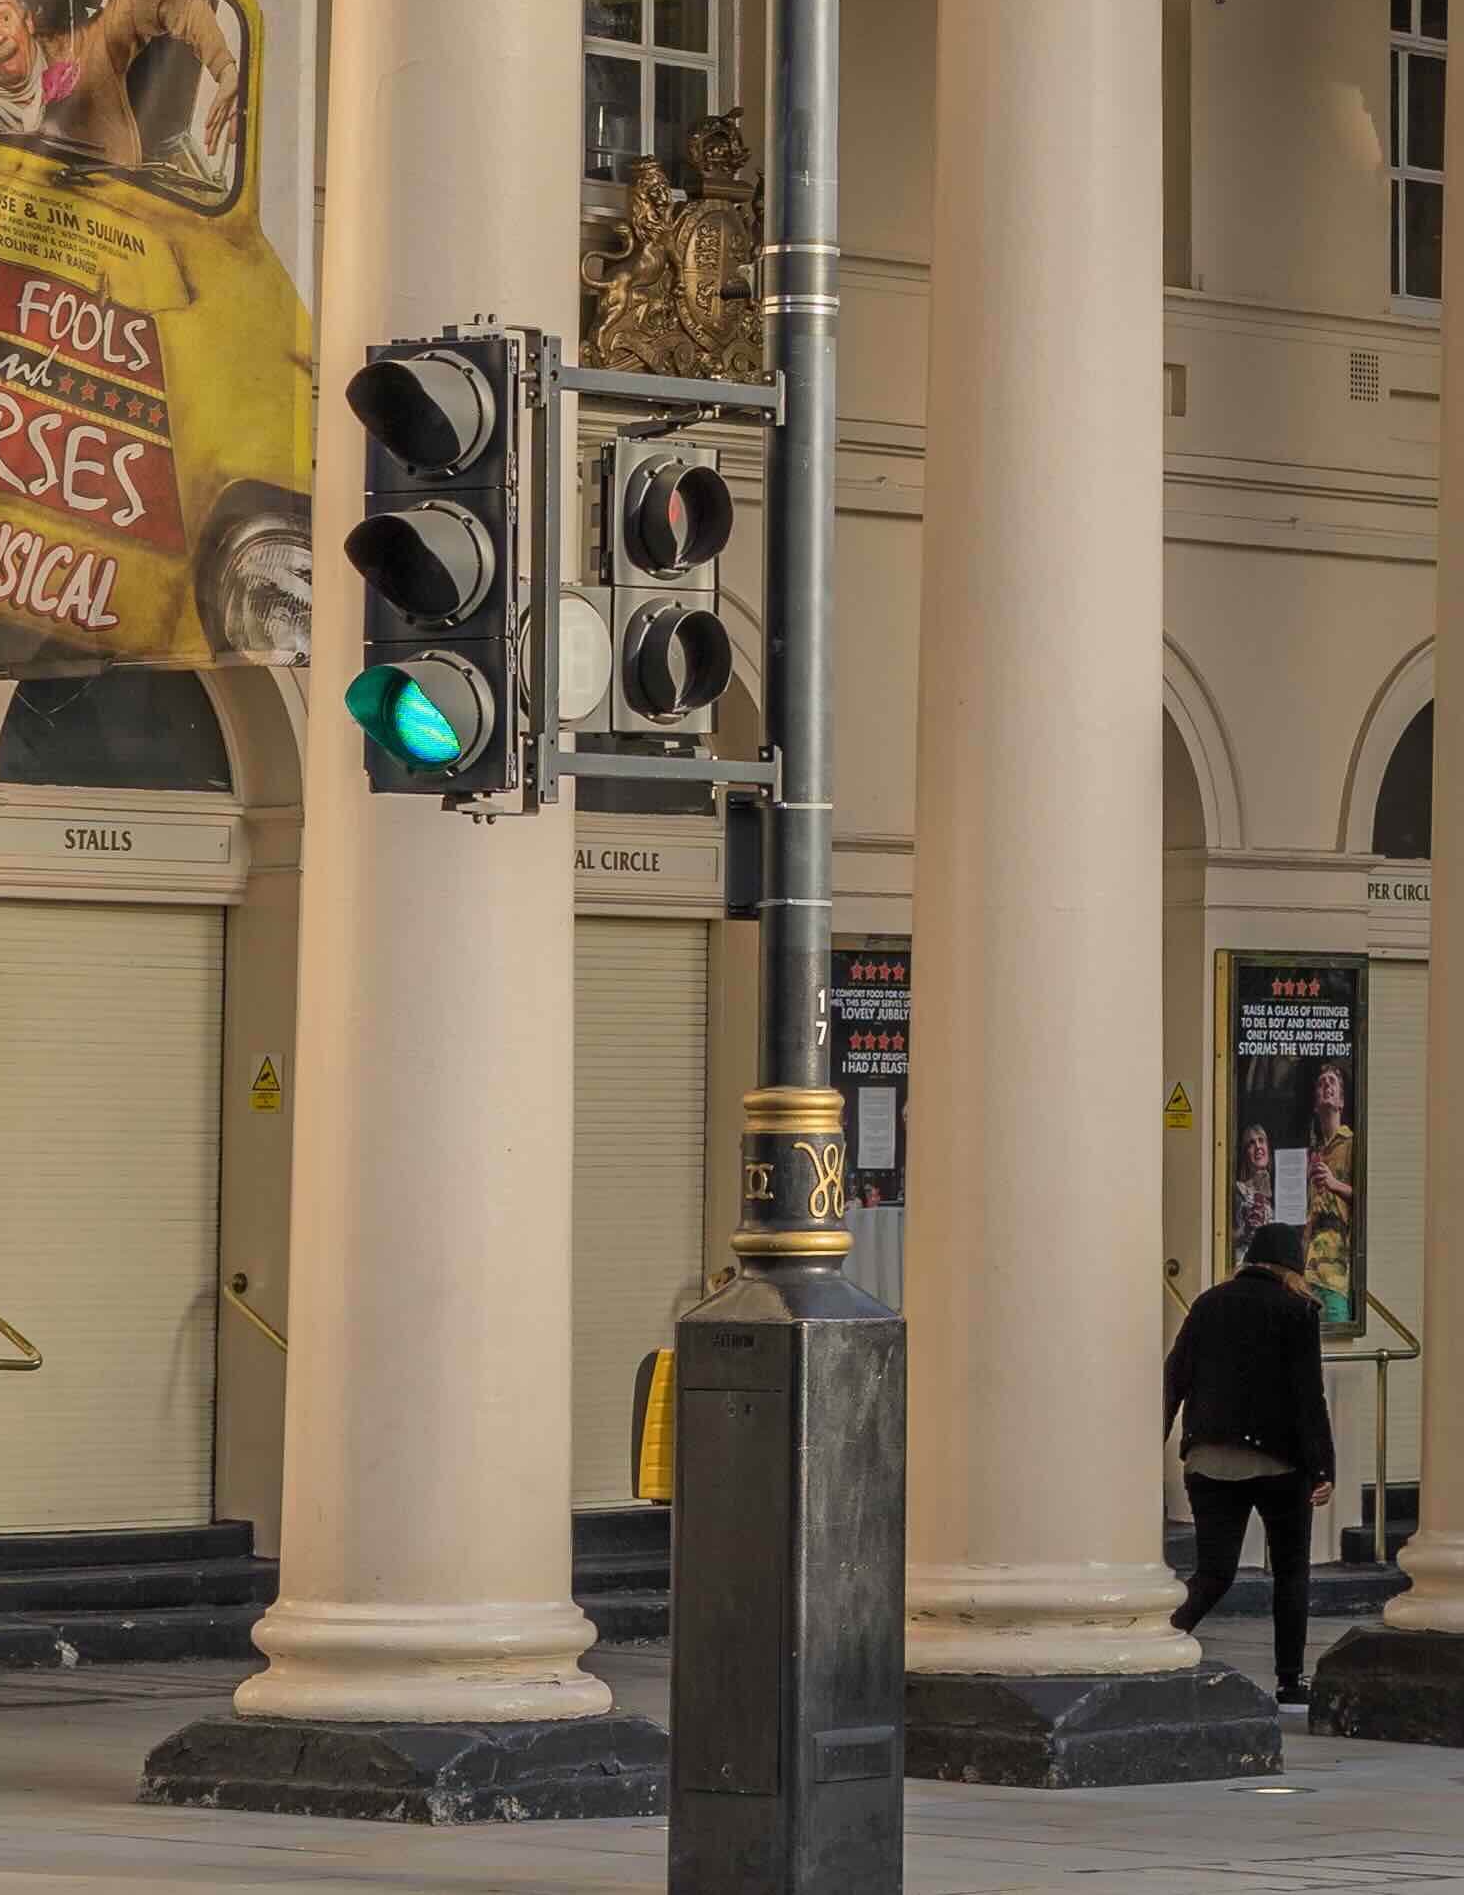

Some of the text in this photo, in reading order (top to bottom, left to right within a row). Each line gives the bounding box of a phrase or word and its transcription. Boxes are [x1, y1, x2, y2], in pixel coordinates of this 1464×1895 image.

[24, 202, 39, 219] &
[46, 207, 81, 232] JIM
[87, 217, 146, 257] SULLIVAN
[41, 246, 64, 264] JAY
[17, 280, 152, 372] FOOLS
[64, 828, 133, 852] STALLS
[600, 850, 661, 872] CIRCLE
[860, 999, 881, 1008] SHOW
[841, 1007, 875, 1020] LOVELY
[1266, 1005, 1274, 1016] A
[1274, 1005, 1299, 1017] GLASS
[1299, 1006, 1312, 1017] OF
[1240, 1017, 1350, 1030] TO DEL BOY AND RODNEY AS
[1246, 1029, 1344, 1042] ONLY FOOLS AND HORSES
[1238, 1042, 1278, 1056] STORMS
[1279, 1042, 1297, 1056] THE
[1298, 1043, 1325, 1056] WEST
[848, 1061, 870, 1074] HAD
[870, 1061, 878, 1074] A
